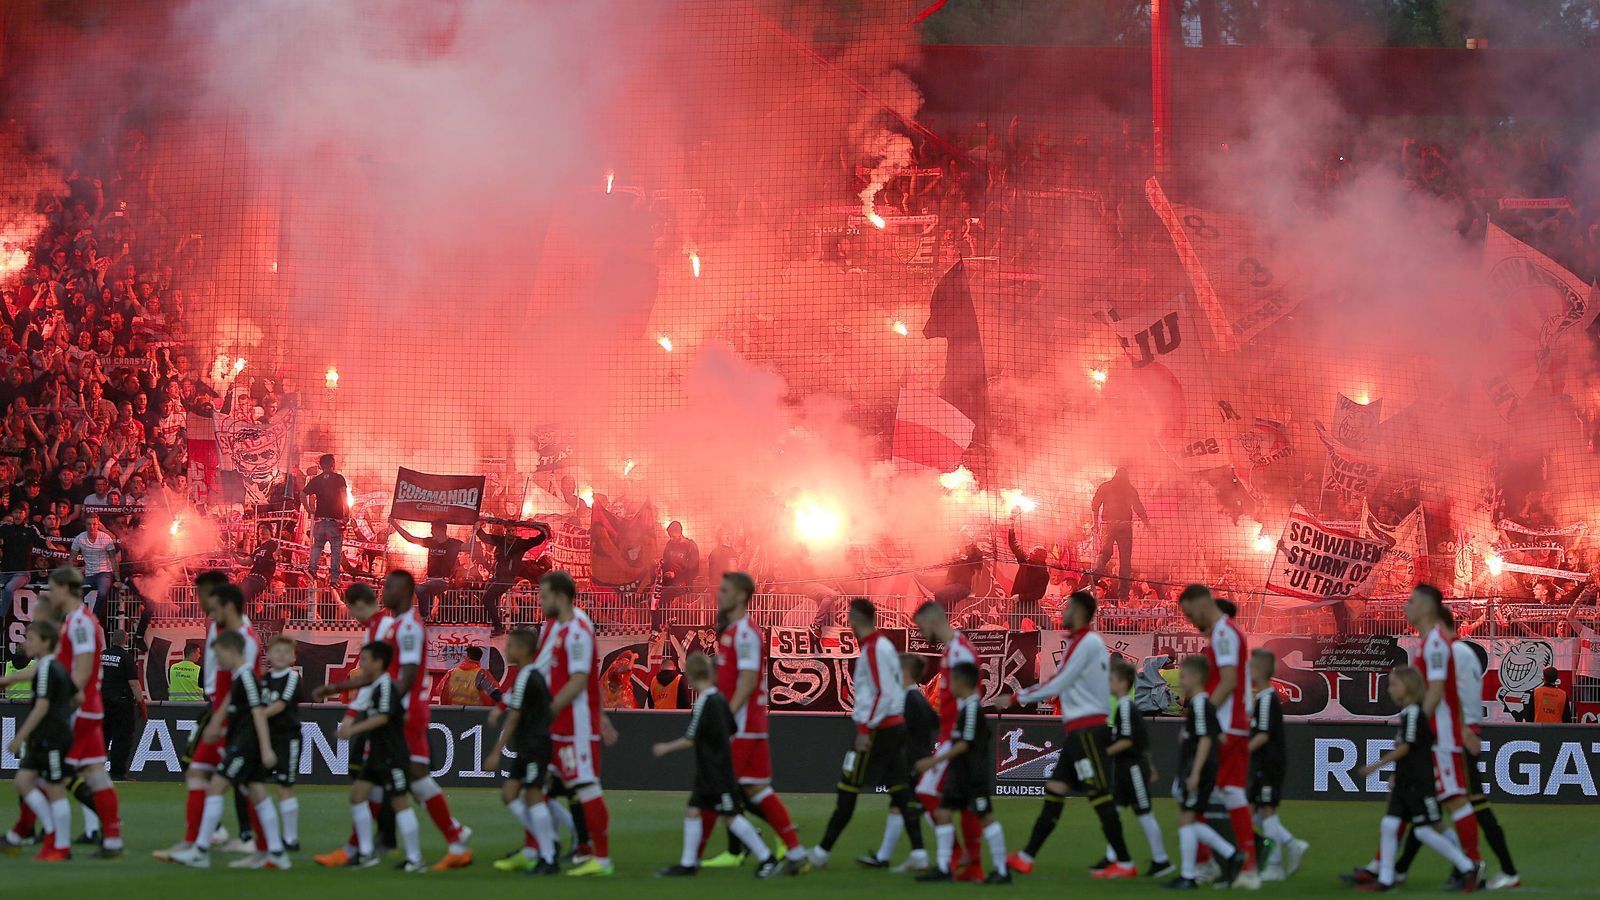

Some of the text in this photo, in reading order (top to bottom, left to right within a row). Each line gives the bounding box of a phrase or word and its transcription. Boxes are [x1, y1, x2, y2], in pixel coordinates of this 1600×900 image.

[397, 480, 479, 506] COMMANDO
[1290, 521, 1384, 564] SCHWABEN
[1288, 545, 1373, 584] STURM 02
[1289, 569, 1356, 598] ULTRAS
[1158, 636, 1209, 653] ULTR
[101, 655, 121, 663] RDNER
[996, 785, 1046, 795] BUNDESL
